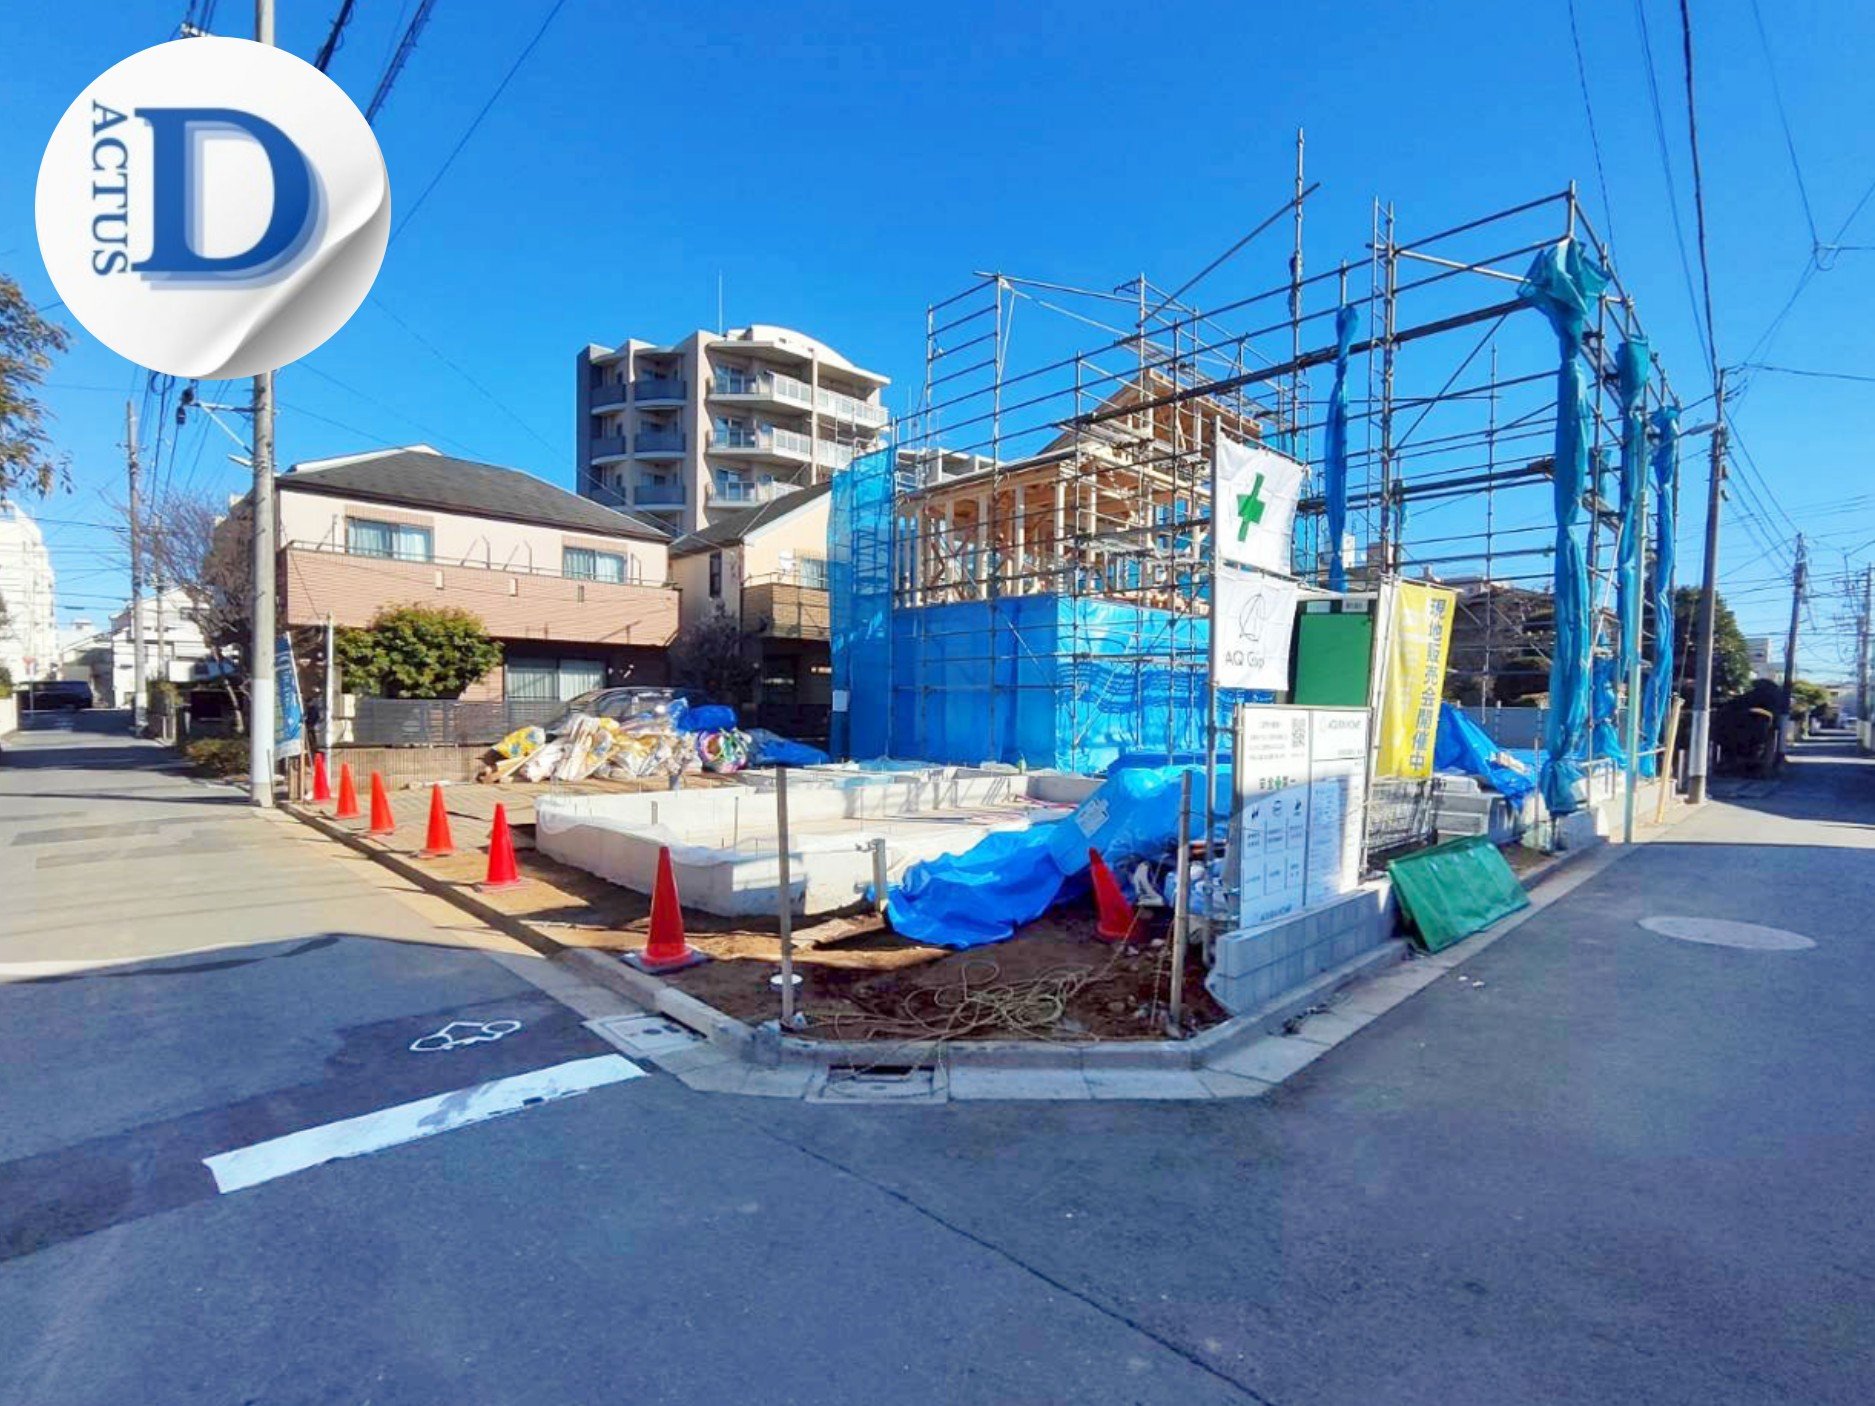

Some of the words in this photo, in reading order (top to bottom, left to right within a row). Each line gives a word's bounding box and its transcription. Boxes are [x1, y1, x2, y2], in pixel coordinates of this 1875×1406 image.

[1409, 599, 1446, 771] 現地販売会開催中
